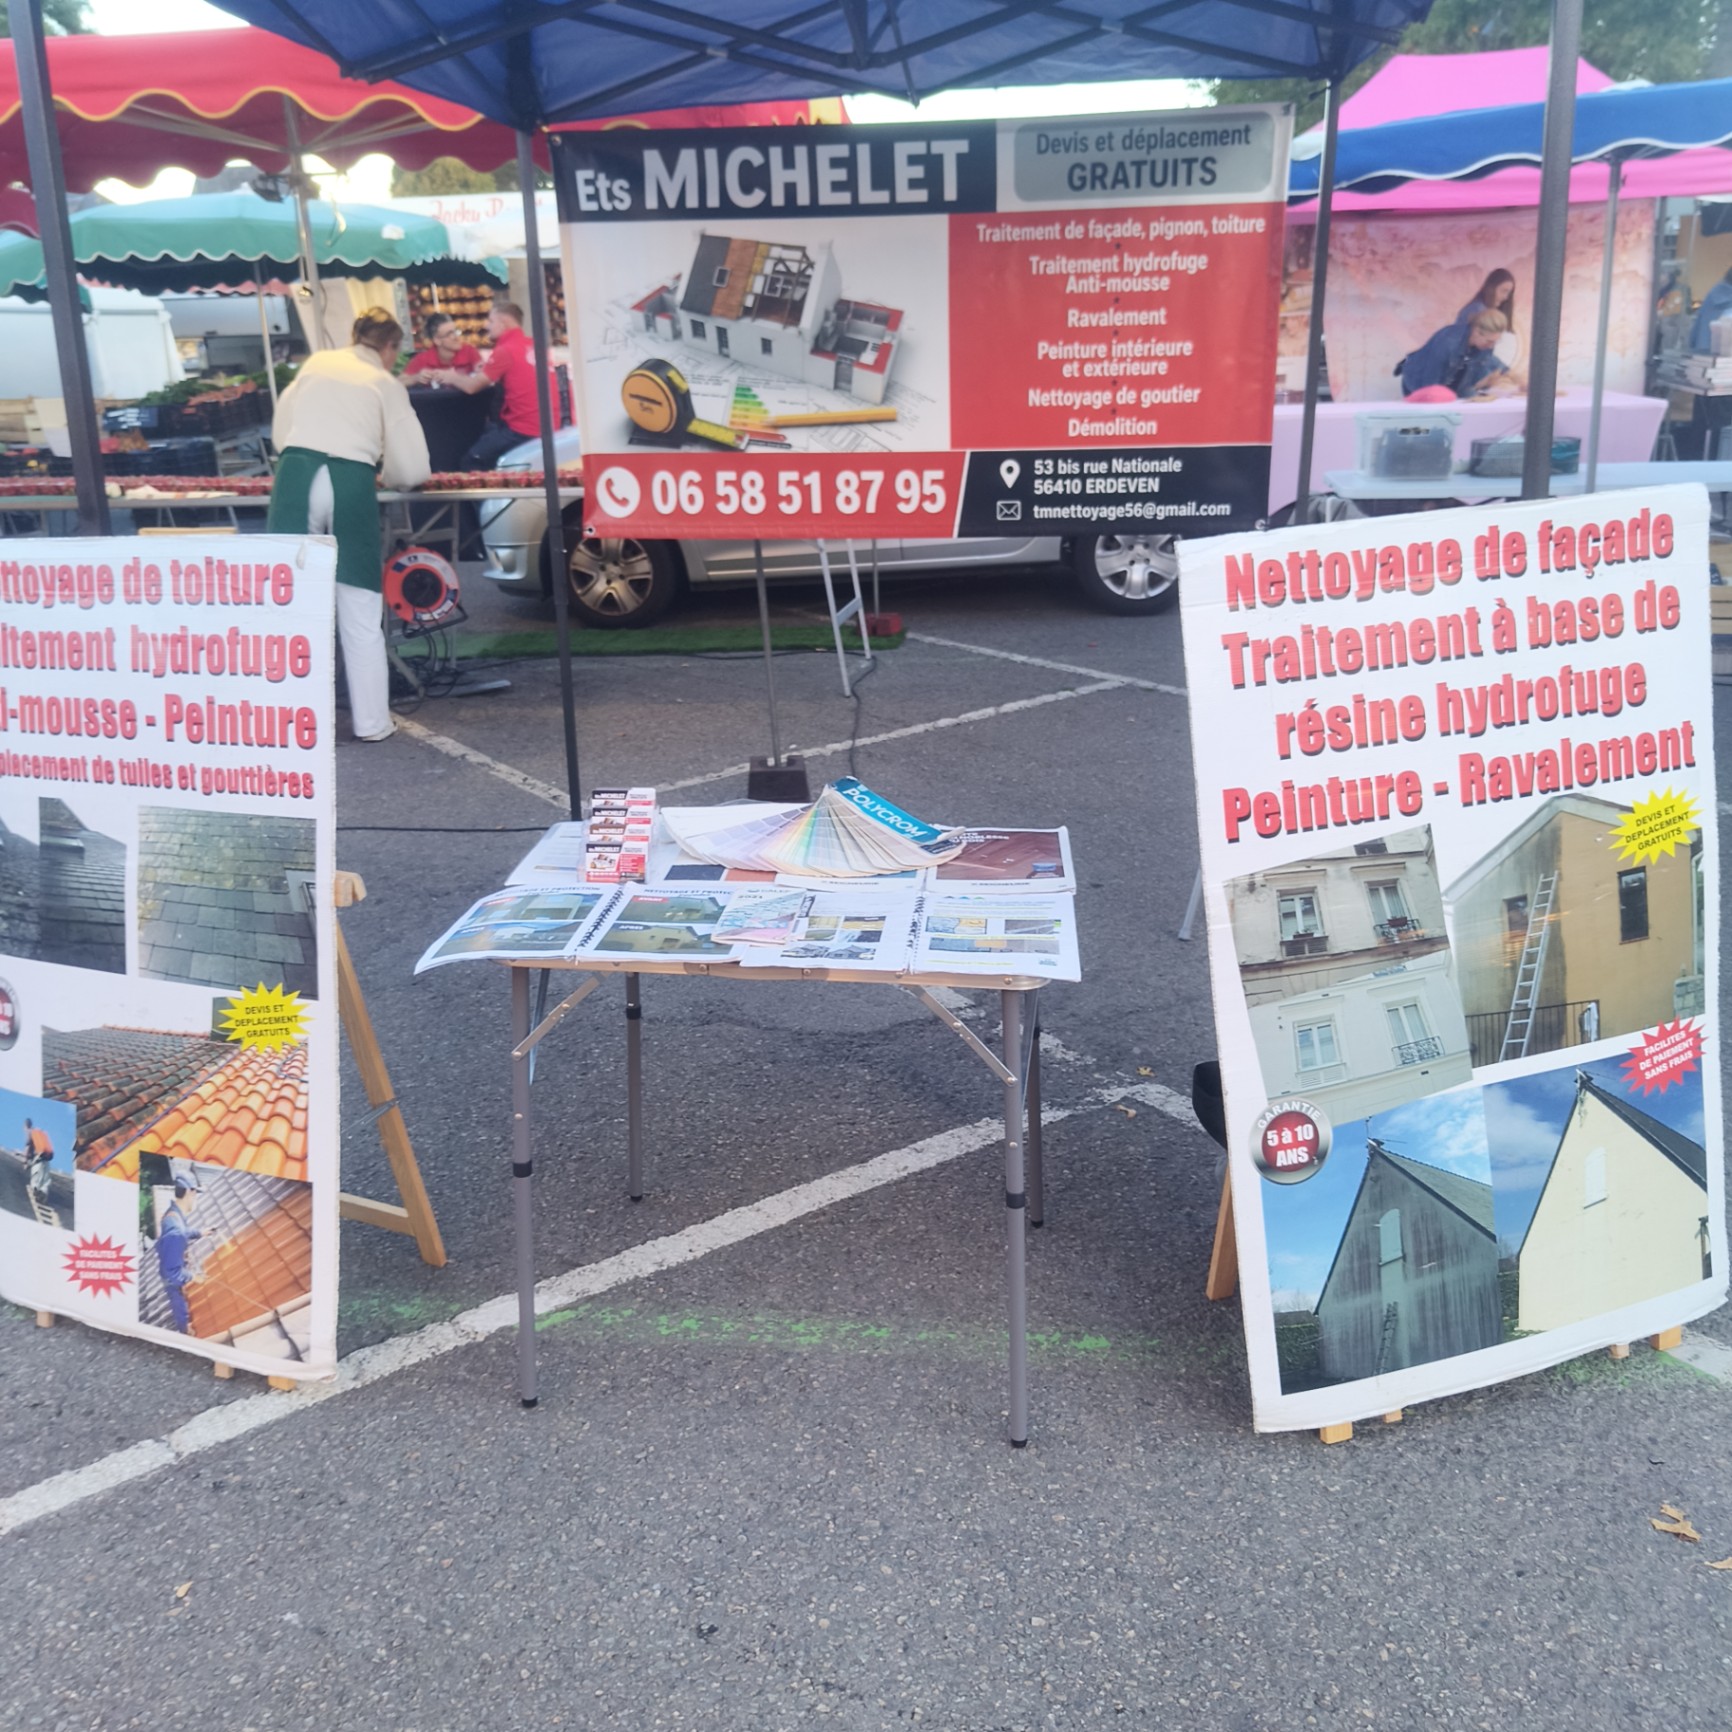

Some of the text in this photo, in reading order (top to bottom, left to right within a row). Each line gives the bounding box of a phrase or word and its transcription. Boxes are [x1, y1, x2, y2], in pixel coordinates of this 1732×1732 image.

[1036, 124, 1251, 155] Devis et déplacement
[575, 139, 969, 212] Ets MICHELET
[1067, 156, 1217, 192] GRATUITS
[977, 214, 1265, 242] Traitement de façade, pignon, toiture
[1029, 250, 1208, 276] Traitement hydrofuge
[1066, 275, 1170, 294] Anti-mousse
[1068, 307, 1167, 328] Ravalement
[1037, 338, 1193, 360] Peinture intérieure
[1062, 358, 1168, 378] et extérieure
[1028, 384, 1200, 410] Nettoyage de goutier
[1068, 416, 1157, 437] Démolition
[1034, 457, 1182, 475] 53 bis rue Nationale
[652, 469, 946, 515] 06 58 51 87 95
[1034, 477, 1160, 495] 56410 ERDEVEN
[1033, 501, 1231, 521] tmnettoyage56@gmail.com
[1224, 508, 1674, 613] Nettoyage de façade
[122, 556, 162, 605] de
[170, 556, 294, 606] toiture
[1221, 580, 1680, 689] Traitement à base de
[130, 624, 311, 683] hydrofuge
[164, 693, 317, 750] Peinture
[1275, 661, 1646, 760] résine hydrofuge
[92, 755, 115, 785] de
[118, 757, 173, 789] tuiles
[177, 763, 197, 792] et
[201, 764, 314, 799] gouttières
[1222, 766, 1422, 843] Peinture
[1458, 720, 1696, 807] Ravalement
[843, 786, 928, 838] POLYCROM
[1635, 804, 1675, 827] DEVIS ET
[1625, 811, 1689, 843] DEPLACEMENT
[1637, 827, 1682, 850] GRATUITS
[235, 1015, 298, 1027] DEPLACEMENT
[245, 1004, 284, 1015] DEVIS ET
[246, 1027, 290, 1038] GRATUITS
[1639, 1058, 1652, 1071] DE
[1644, 1050, 1693, 1080] SANS FRAIS
[1257, 1100, 1321, 1128] GARANTIE
[1266, 1123, 1314, 1147] 5 à 10
[1276, 1146, 1309, 1167] ANS
